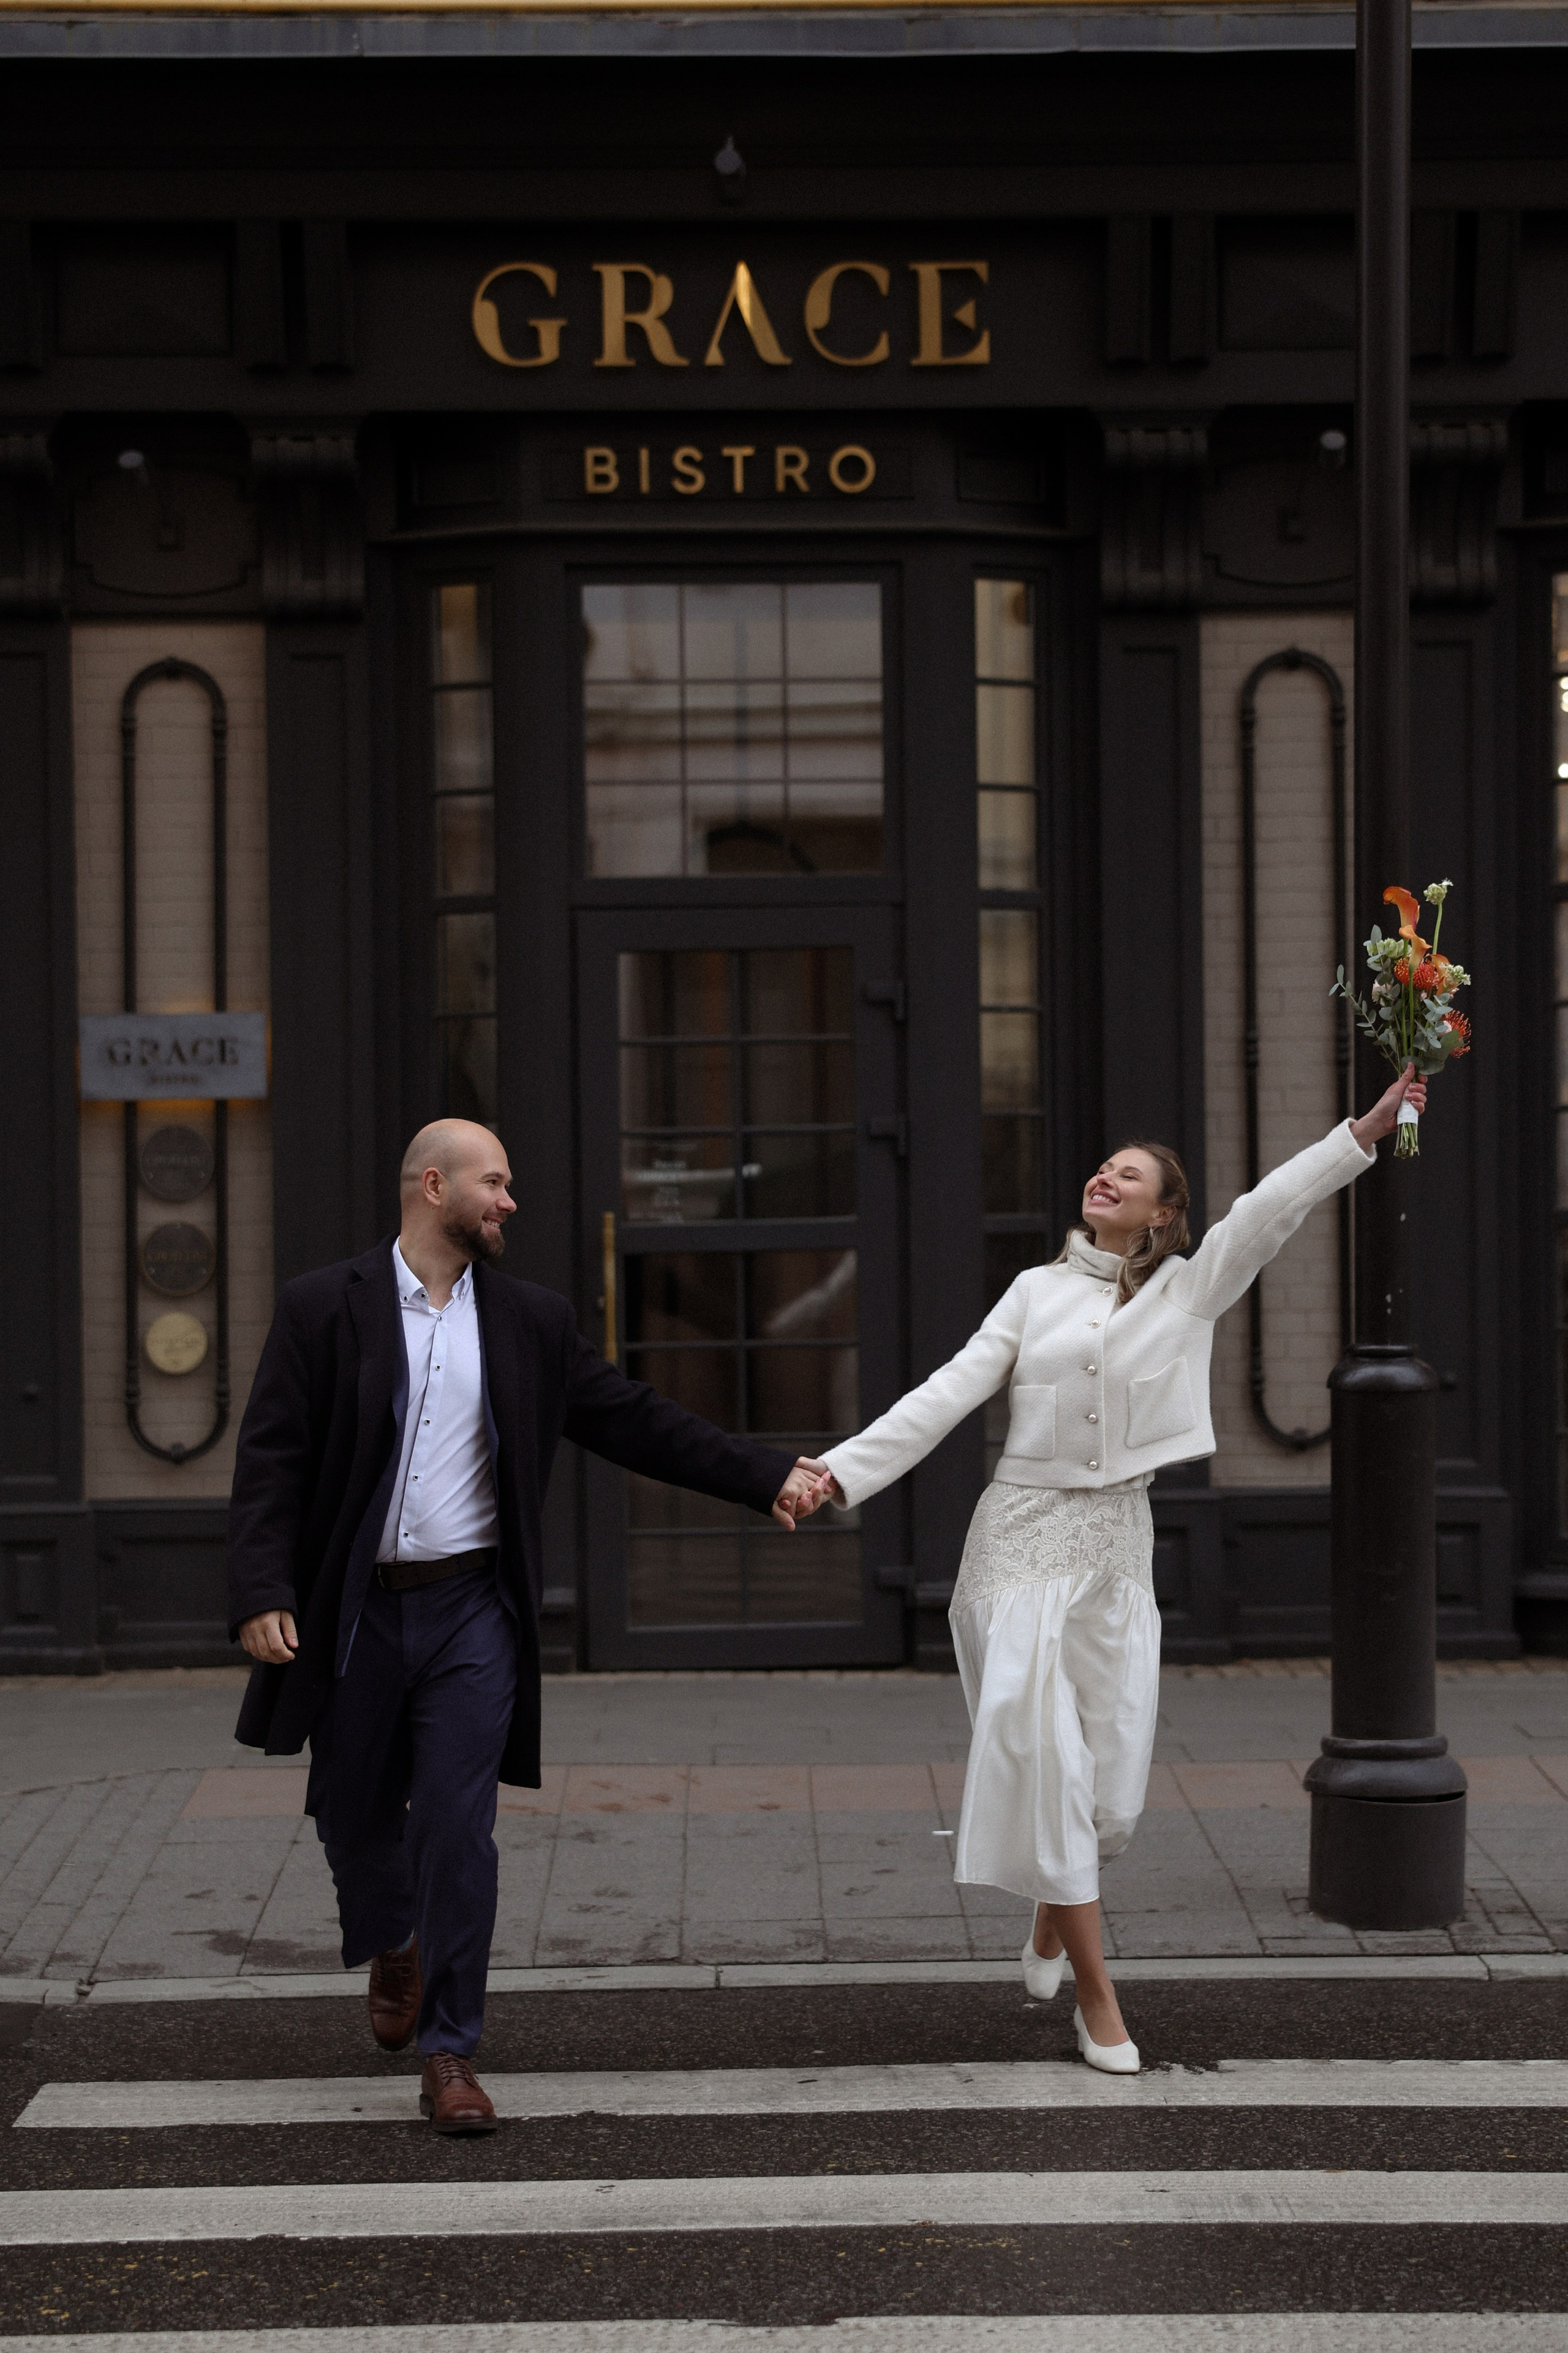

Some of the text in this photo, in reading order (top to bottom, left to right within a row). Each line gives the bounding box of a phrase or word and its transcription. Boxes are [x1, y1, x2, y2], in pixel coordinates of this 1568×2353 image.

[472, 260, 990, 366] GRACE
[583, 444, 876, 494] BISTRO
[106, 1038, 239, 1066] GRACE
